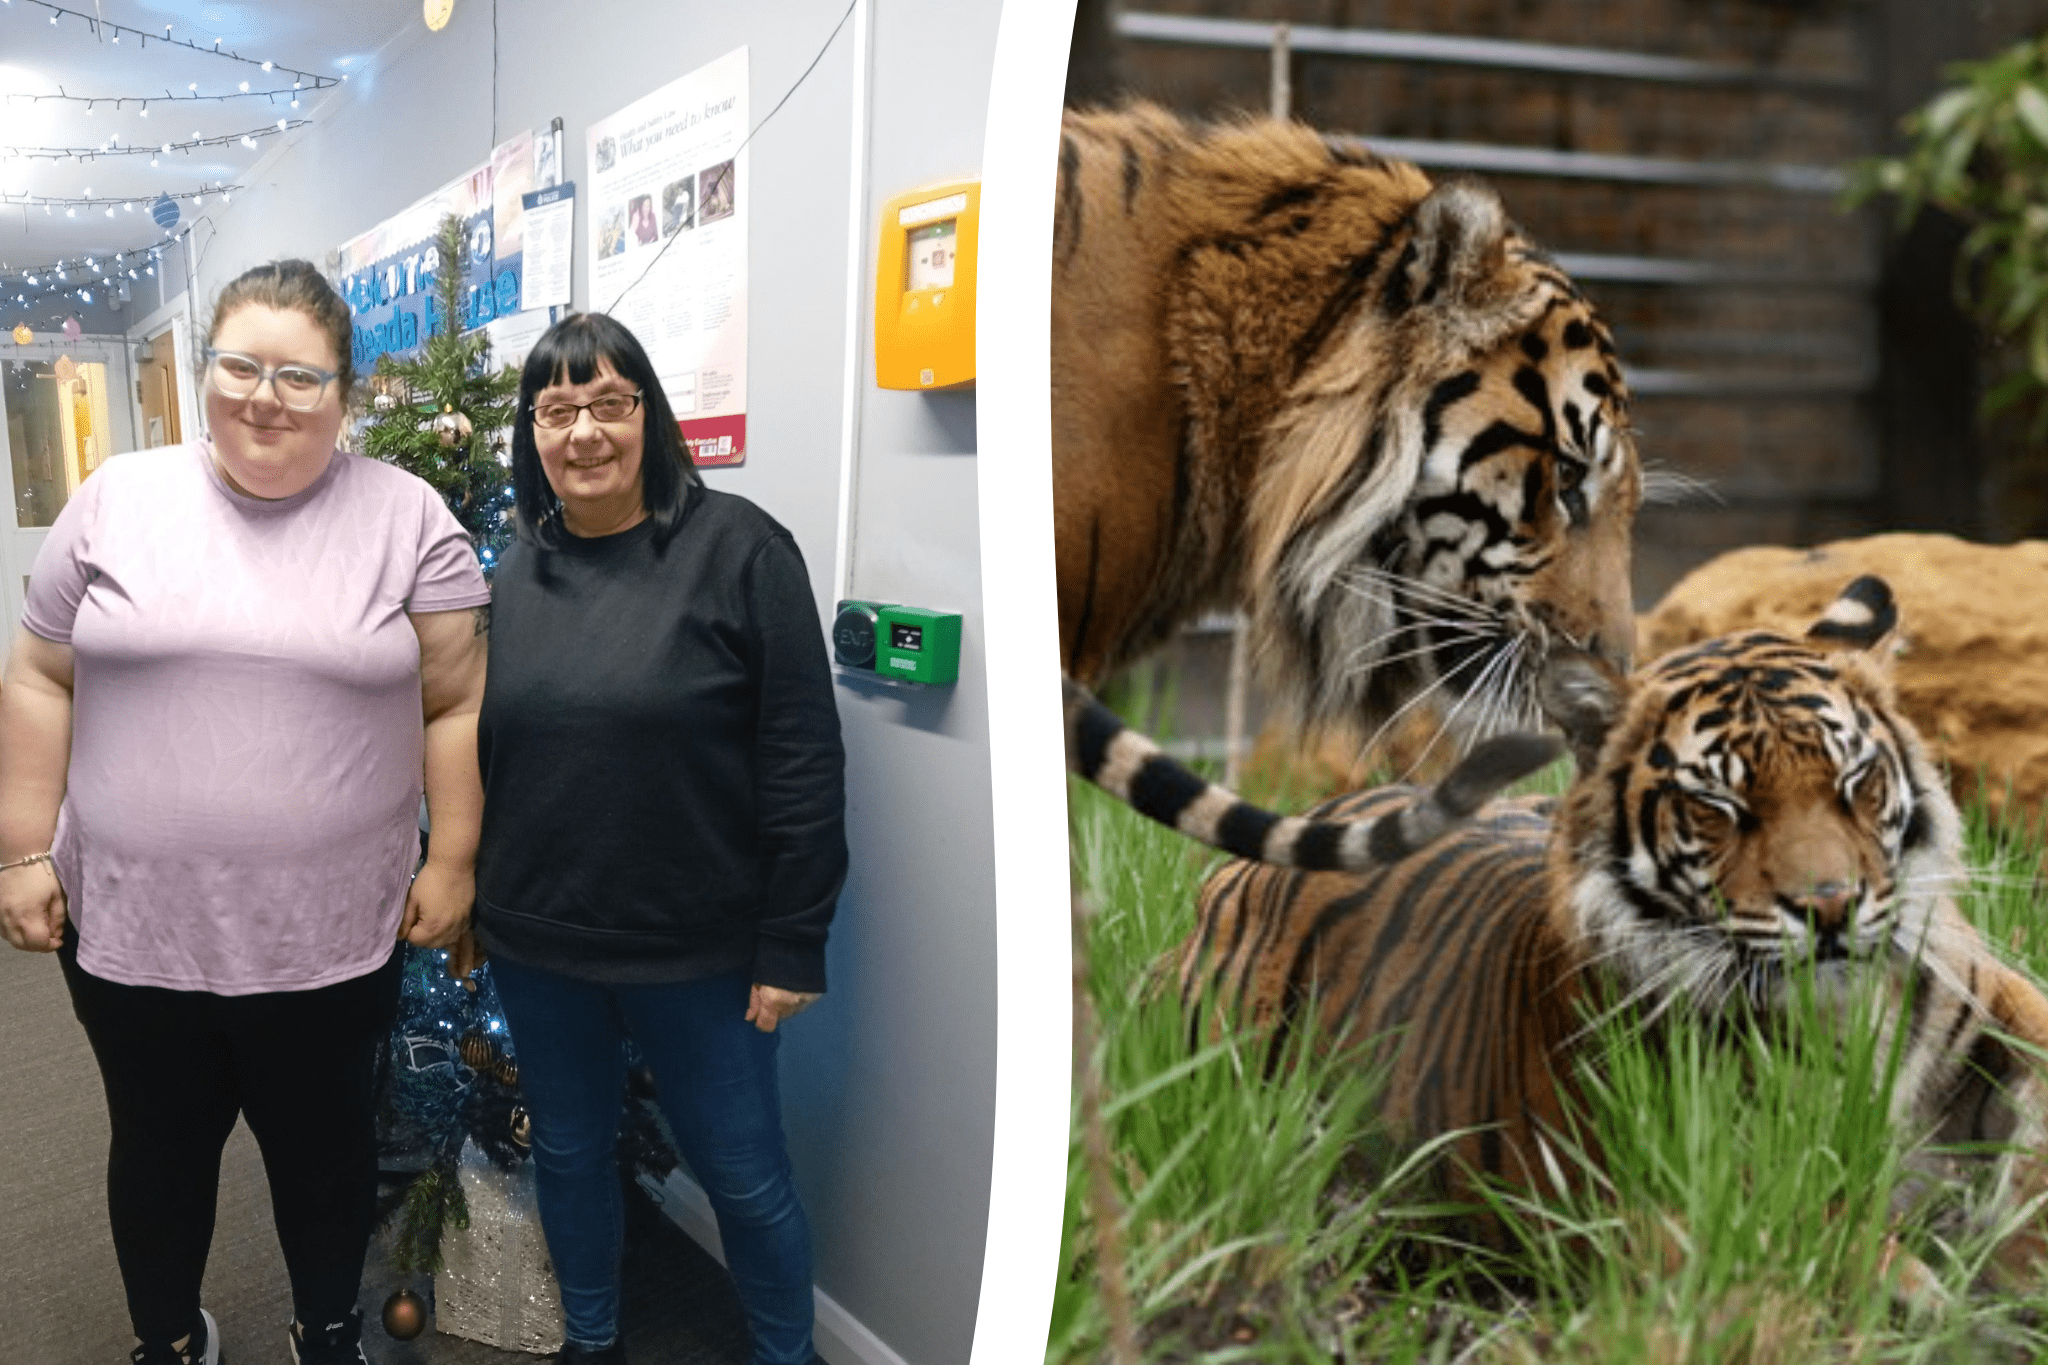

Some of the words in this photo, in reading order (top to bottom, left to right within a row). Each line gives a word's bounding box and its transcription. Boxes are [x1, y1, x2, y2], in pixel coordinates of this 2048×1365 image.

[620, 137, 643, 159] What
[645, 130, 663, 152] you
[665, 111, 689, 138] need
[690, 112, 702, 127] to
[704, 95, 736, 121] know
[425, 269, 518, 337] Hse
